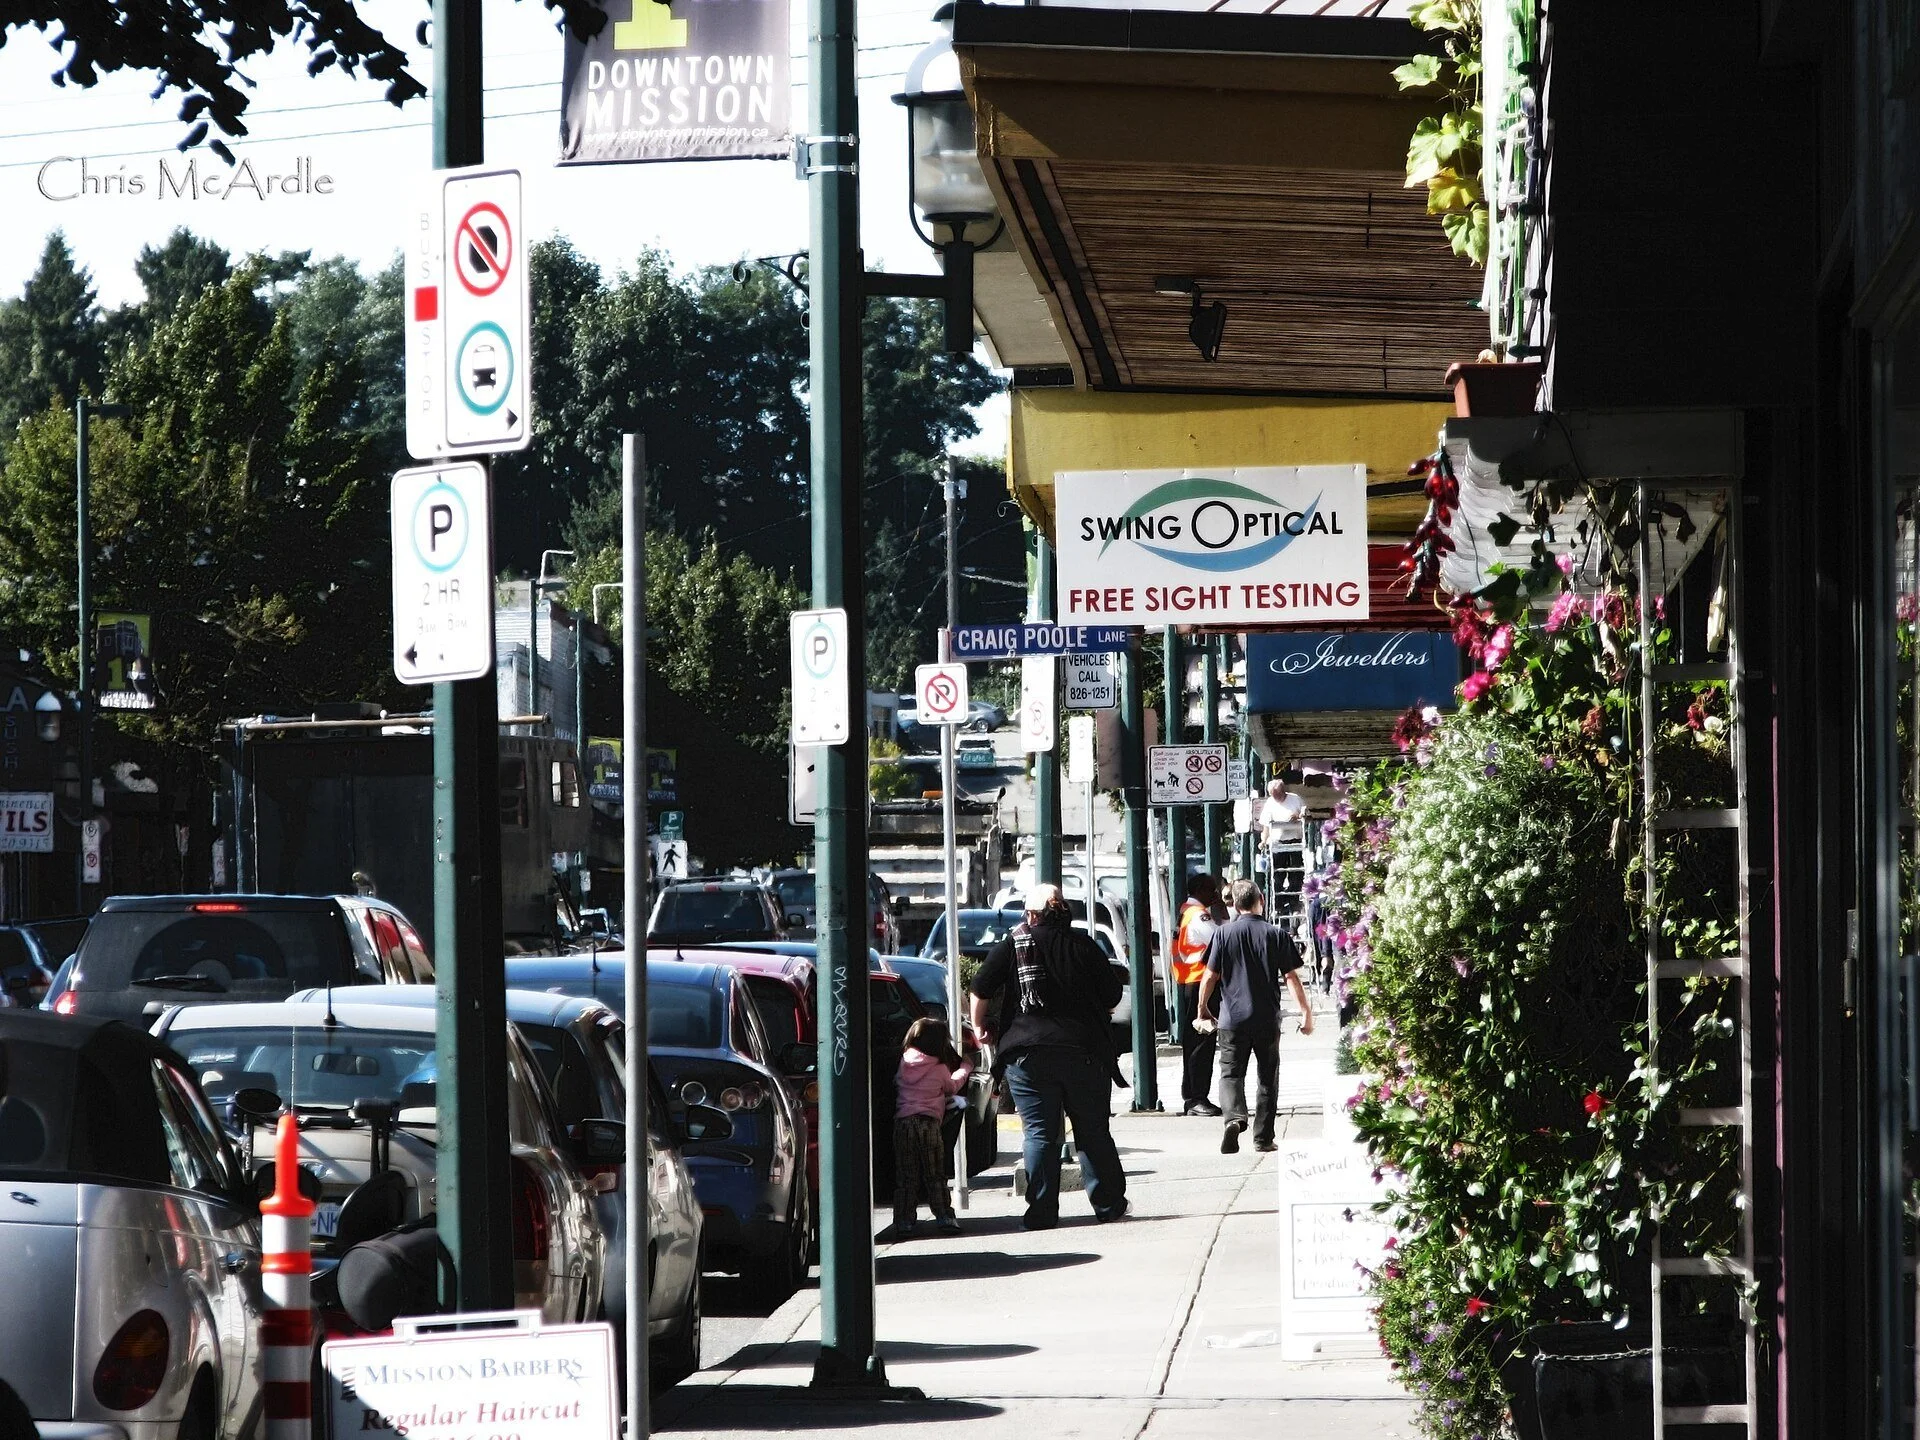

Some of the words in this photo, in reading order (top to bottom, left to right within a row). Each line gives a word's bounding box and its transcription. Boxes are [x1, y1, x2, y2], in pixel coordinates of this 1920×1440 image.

[588, 56, 774, 89] DOWNTOWN
[584, 85, 773, 129] MISSION
[420, 212, 431, 279] BUS
[421, 326, 432, 414] STOP
[1081, 515, 1181, 542] SWING
[1191, 500, 1343, 549] OPTICAL
[422, 581, 431, 606] 2
[437, 578, 461, 604] HR
[1069, 587, 1134, 613] FREE
[1145, 585, 1232, 611] SIGHT
[1241, 581, 1360, 609] TESTING
[958, 628, 1017, 651] CRAIG
[1024, 626, 1087, 649] POOLE
[1098, 630, 1126, 644] LANE
[1270, 632, 1430, 675] Jewellers
[1068, 653, 1111, 667] VEHICLES
[1078, 671, 1101, 682] CALL
[1070, 687, 1110, 700] 826-1251
[0, 810, 48, 832] ILS
[1285, 1151, 1309, 1165] The
[1285, 1155, 1348, 1181] Natural
[363, 1363, 474, 1387] MISSION
[479, 1357, 584, 1379] BARBERS
[359, 1402, 468, 1437] Regular
[476, 1399, 582, 1424] Haircut
